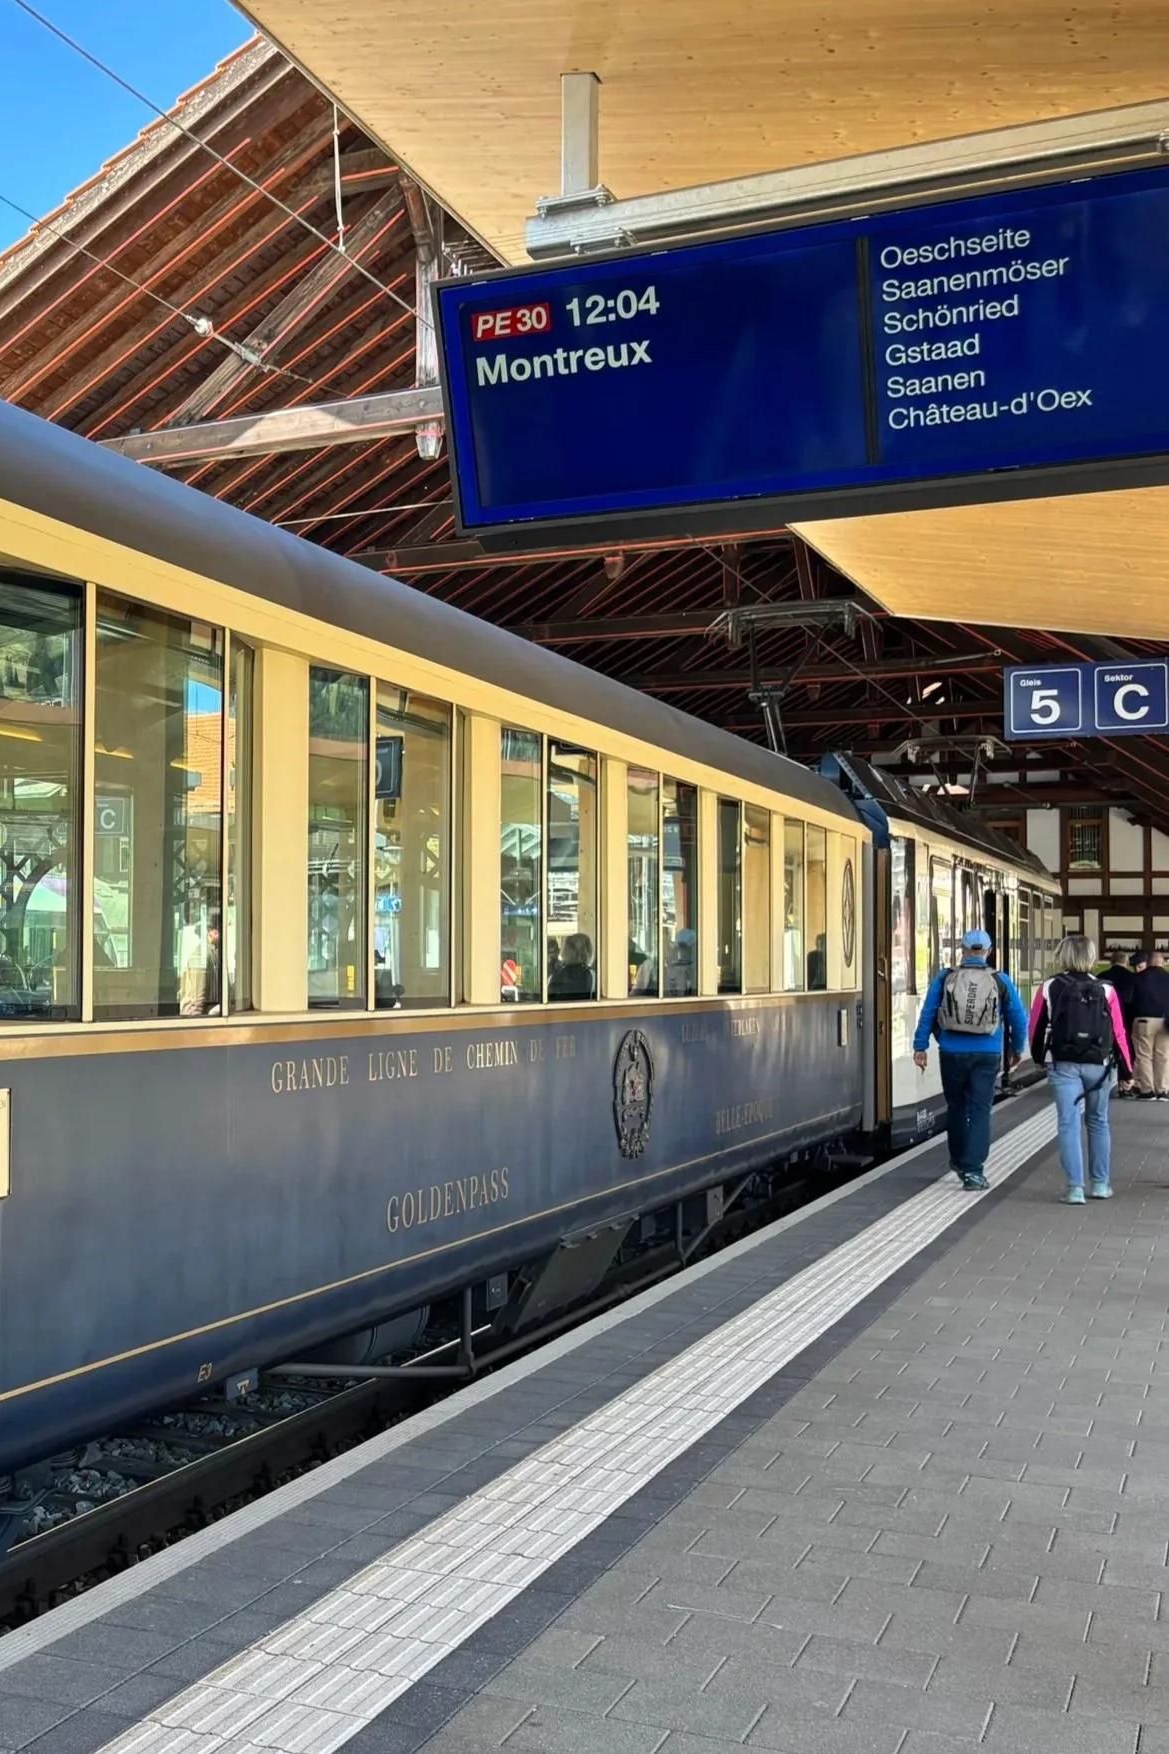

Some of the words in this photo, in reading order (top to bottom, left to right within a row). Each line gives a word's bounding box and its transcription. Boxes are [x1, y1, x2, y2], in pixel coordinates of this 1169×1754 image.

[880, 228, 1031, 269] Oeschseite
[882, 257, 1070, 302] Saanenmöser
[476, 312, 512, 338] PE
[516, 306, 547, 332] 30
[565, 285, 660, 327] 12:04
[883, 294, 1019, 335] Schönried
[475, 340, 652, 386] Montreux
[885, 333, 980, 366] Gstaad
[886, 370, 985, 398] Saanen
[888, 388, 1093, 430] Château-d'Oex
[1020, 679, 1042, 687] Gleis
[1104, 674, 1133, 683] Sektor
[1030, 689, 1061, 725] 5
[1113, 683, 1150, 721] C
[100, 808, 116, 830] C
[964, 980, 978, 1025] SUPERDRY
[271, 1055, 349, 1093] GRANDE
[367, 1049, 418, 1081] LIGNE
[433, 1046, 453, 1073] DE
[466, 1040, 518, 1069] CHEMIN
[529, 1038, 544, 1063] DE
[387, 1166, 509, 1232] GOLDENPASS
[197, 1362, 213, 1383] E3
